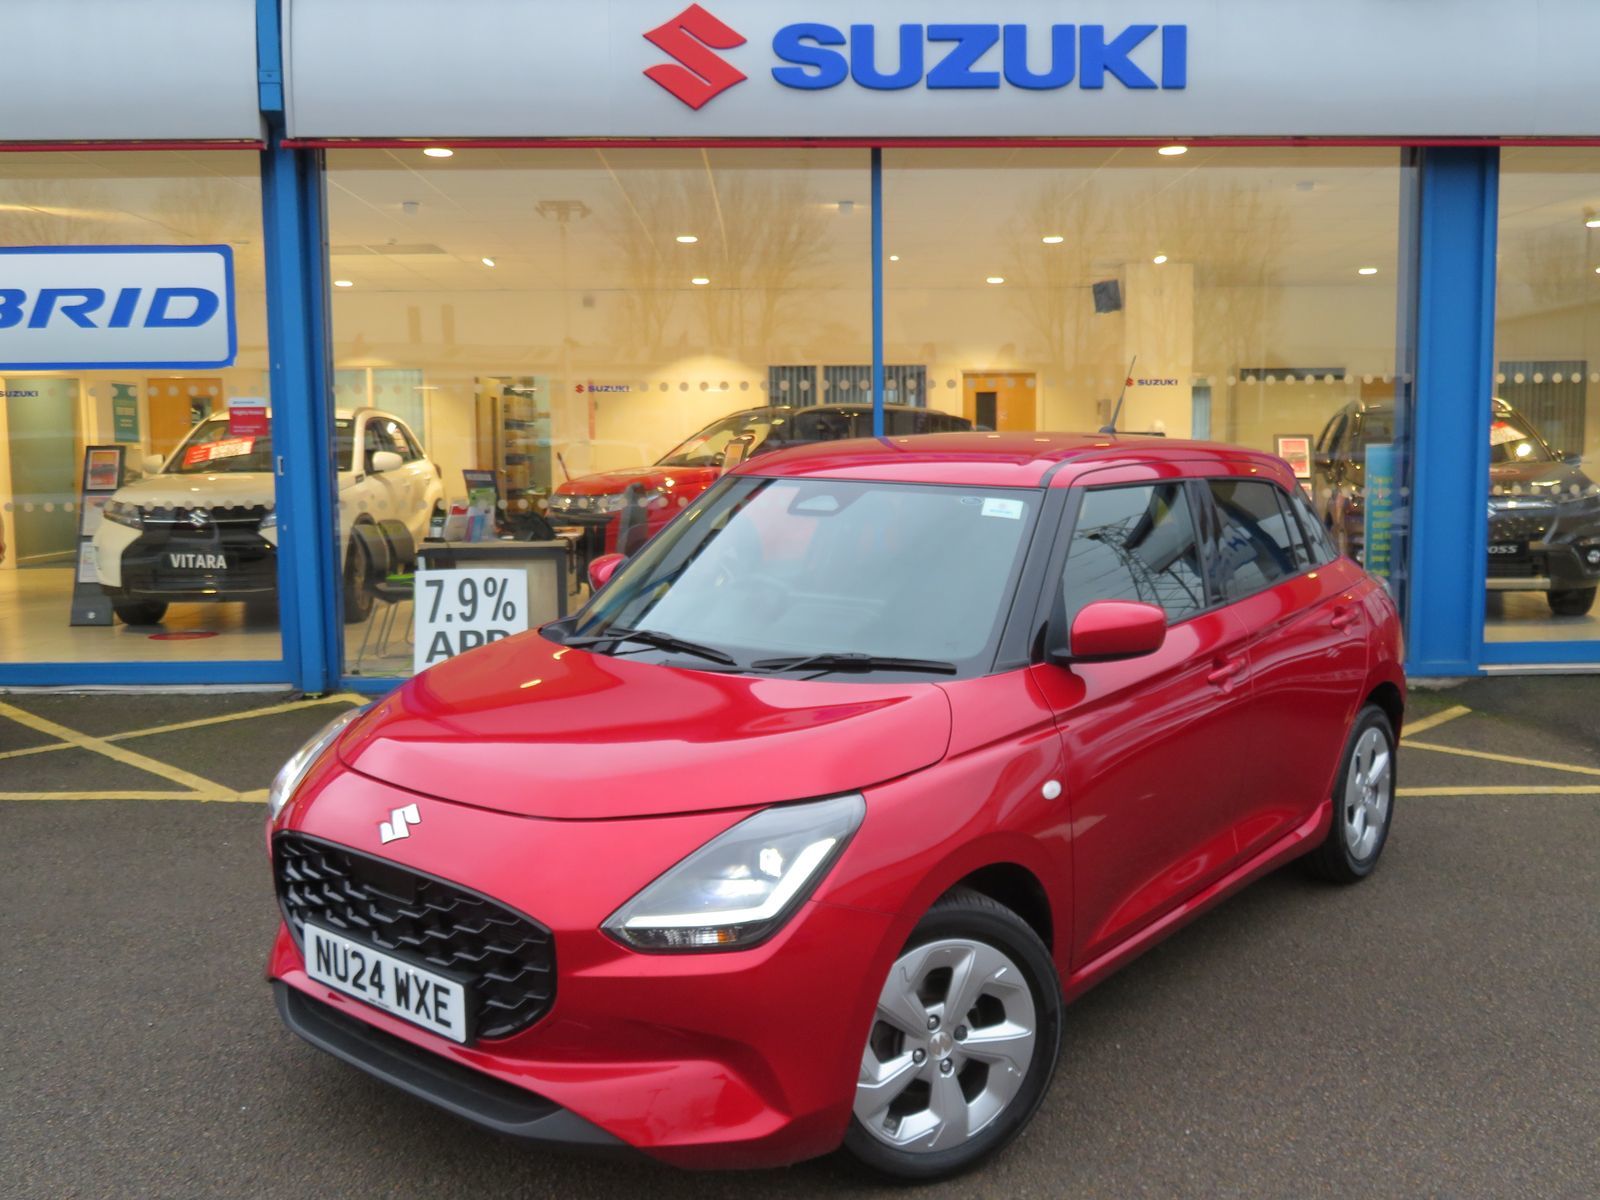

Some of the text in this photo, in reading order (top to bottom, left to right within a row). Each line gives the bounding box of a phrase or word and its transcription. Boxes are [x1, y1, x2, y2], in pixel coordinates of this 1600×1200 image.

[771, 22, 1188, 90] SUZUKI
[170, 553, 227, 569] VITARA
[425, 576, 516, 623] 7.9%
[315, 935, 452, 1029] NU24 WXE
